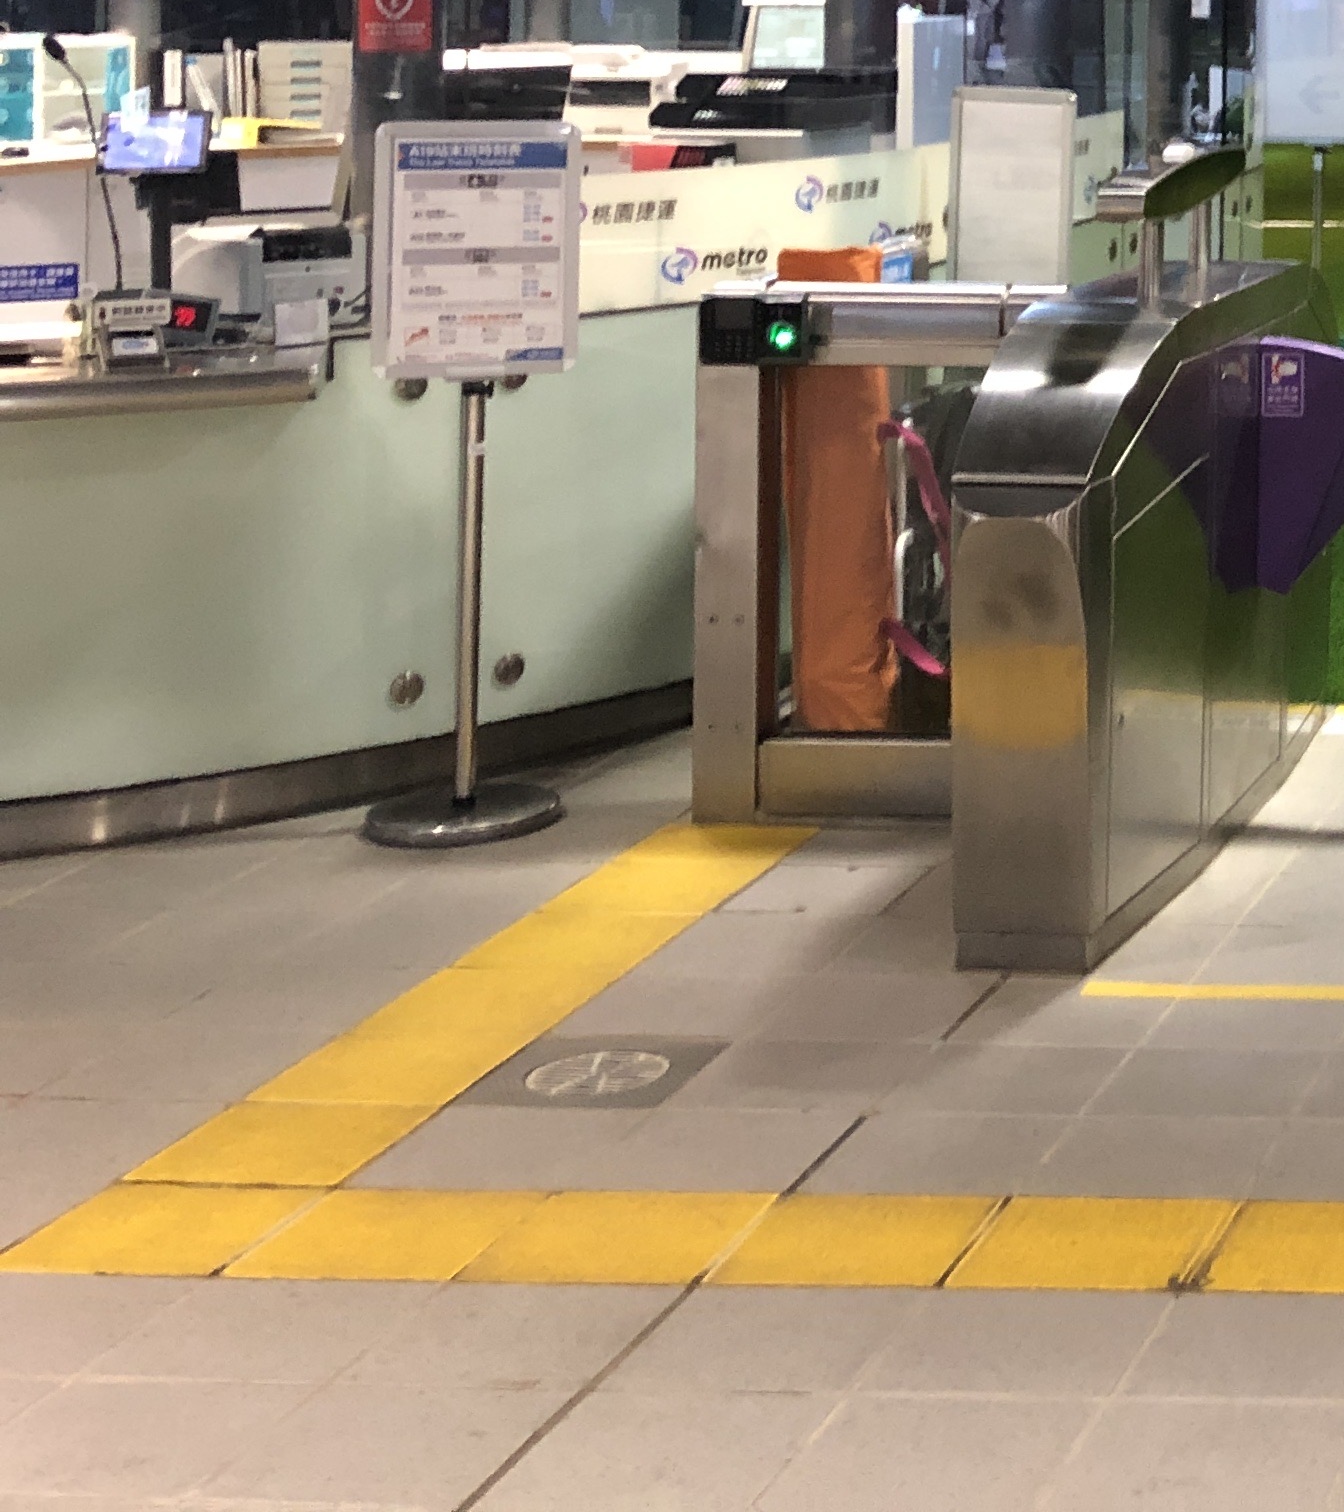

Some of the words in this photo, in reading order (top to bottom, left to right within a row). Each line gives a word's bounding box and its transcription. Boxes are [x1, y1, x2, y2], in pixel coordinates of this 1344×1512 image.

[592, 199, 677, 225] 桃園捷運
[701, 246, 768, 271] metro
